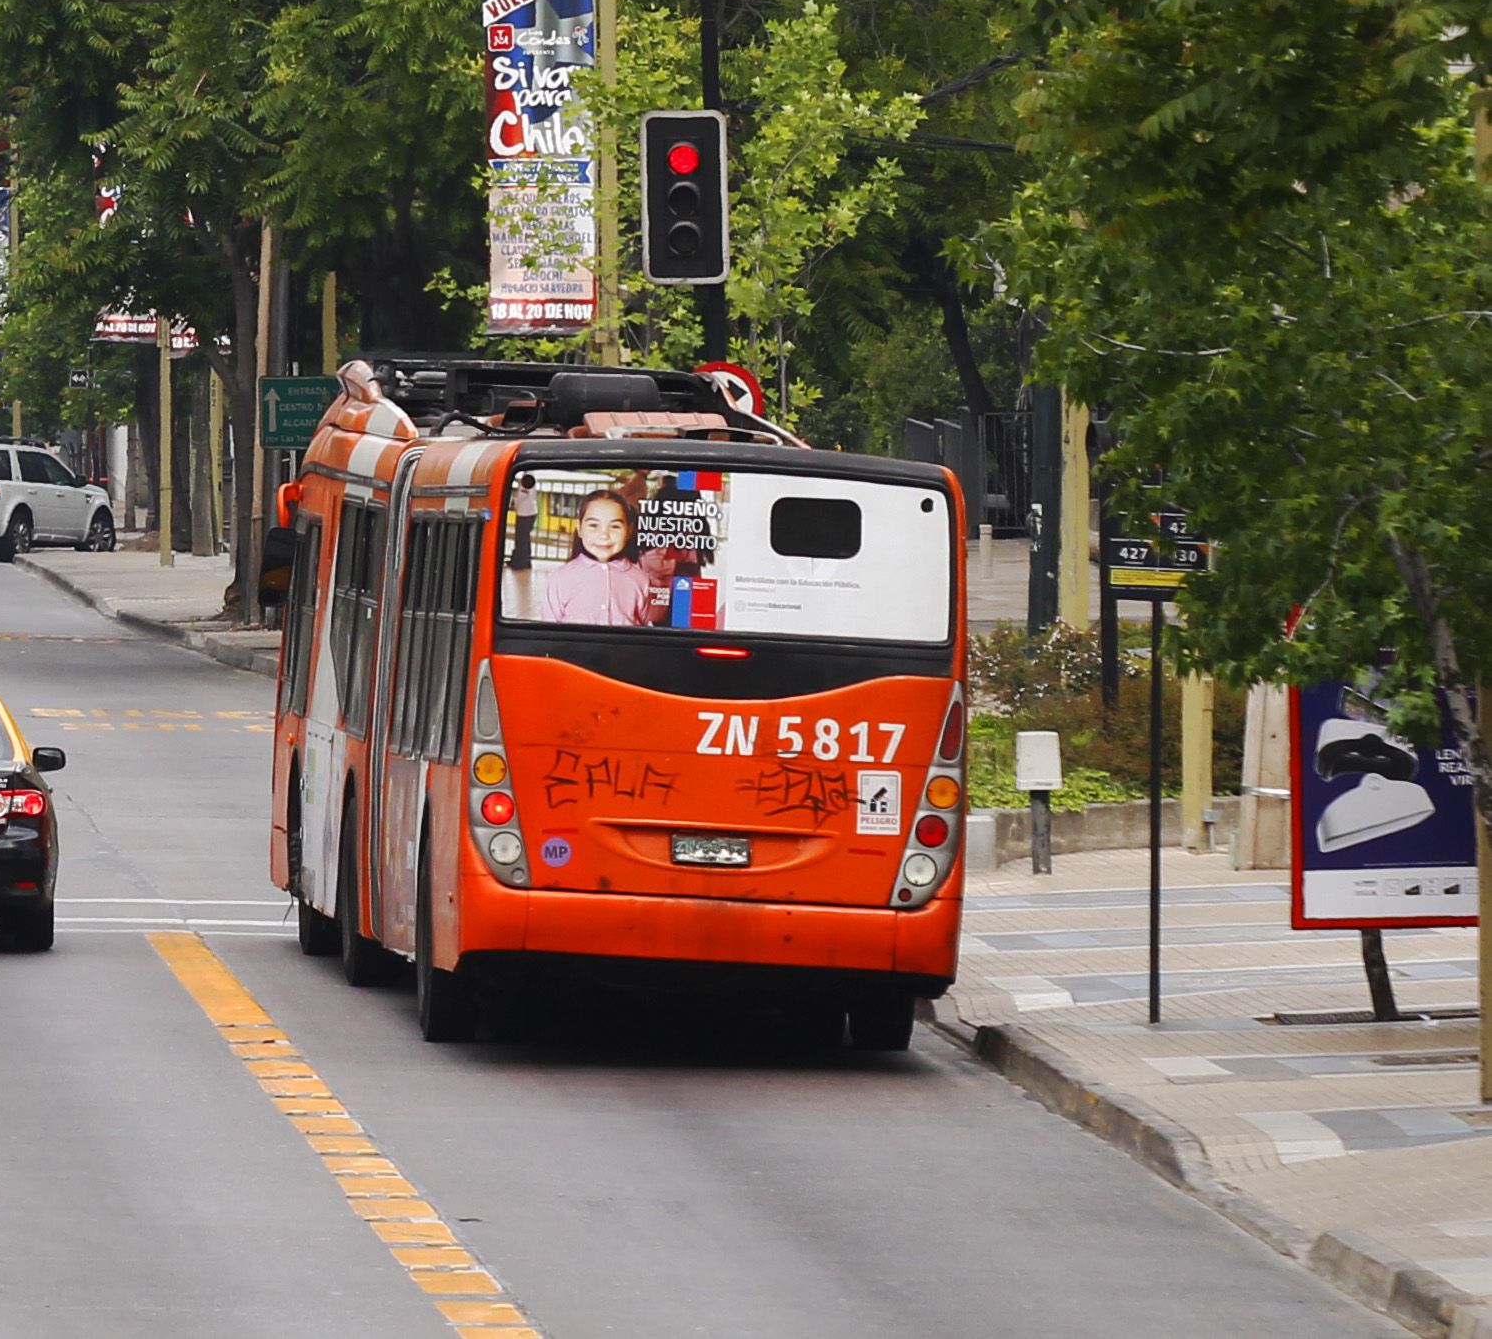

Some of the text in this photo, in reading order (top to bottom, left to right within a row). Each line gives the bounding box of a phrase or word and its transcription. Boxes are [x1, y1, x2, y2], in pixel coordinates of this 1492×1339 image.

[491, 56, 581, 91] Si va
[513, 88, 573, 116] para
[489, 110, 586, 157] Chile
[491, 303, 507, 319] 18
[526, 304, 543, 319] 20
[545, 303, 563, 319] DE
[564, 303, 593, 320] NOV
[287, 387, 328, 397] ENTRADA
[279, 403, 314, 412] CENTRO
[638, 499, 723, 520] TU SUEÑO,
[638, 516, 704, 533] NUESTRO
[1169, 522, 1188, 534] 42
[1118, 547, 1198, 563] 427 30
[696, 711, 906, 764] ZN 5817
[860, 817, 898, 826] PELIGRO
[544, 845, 568, 859] MP
